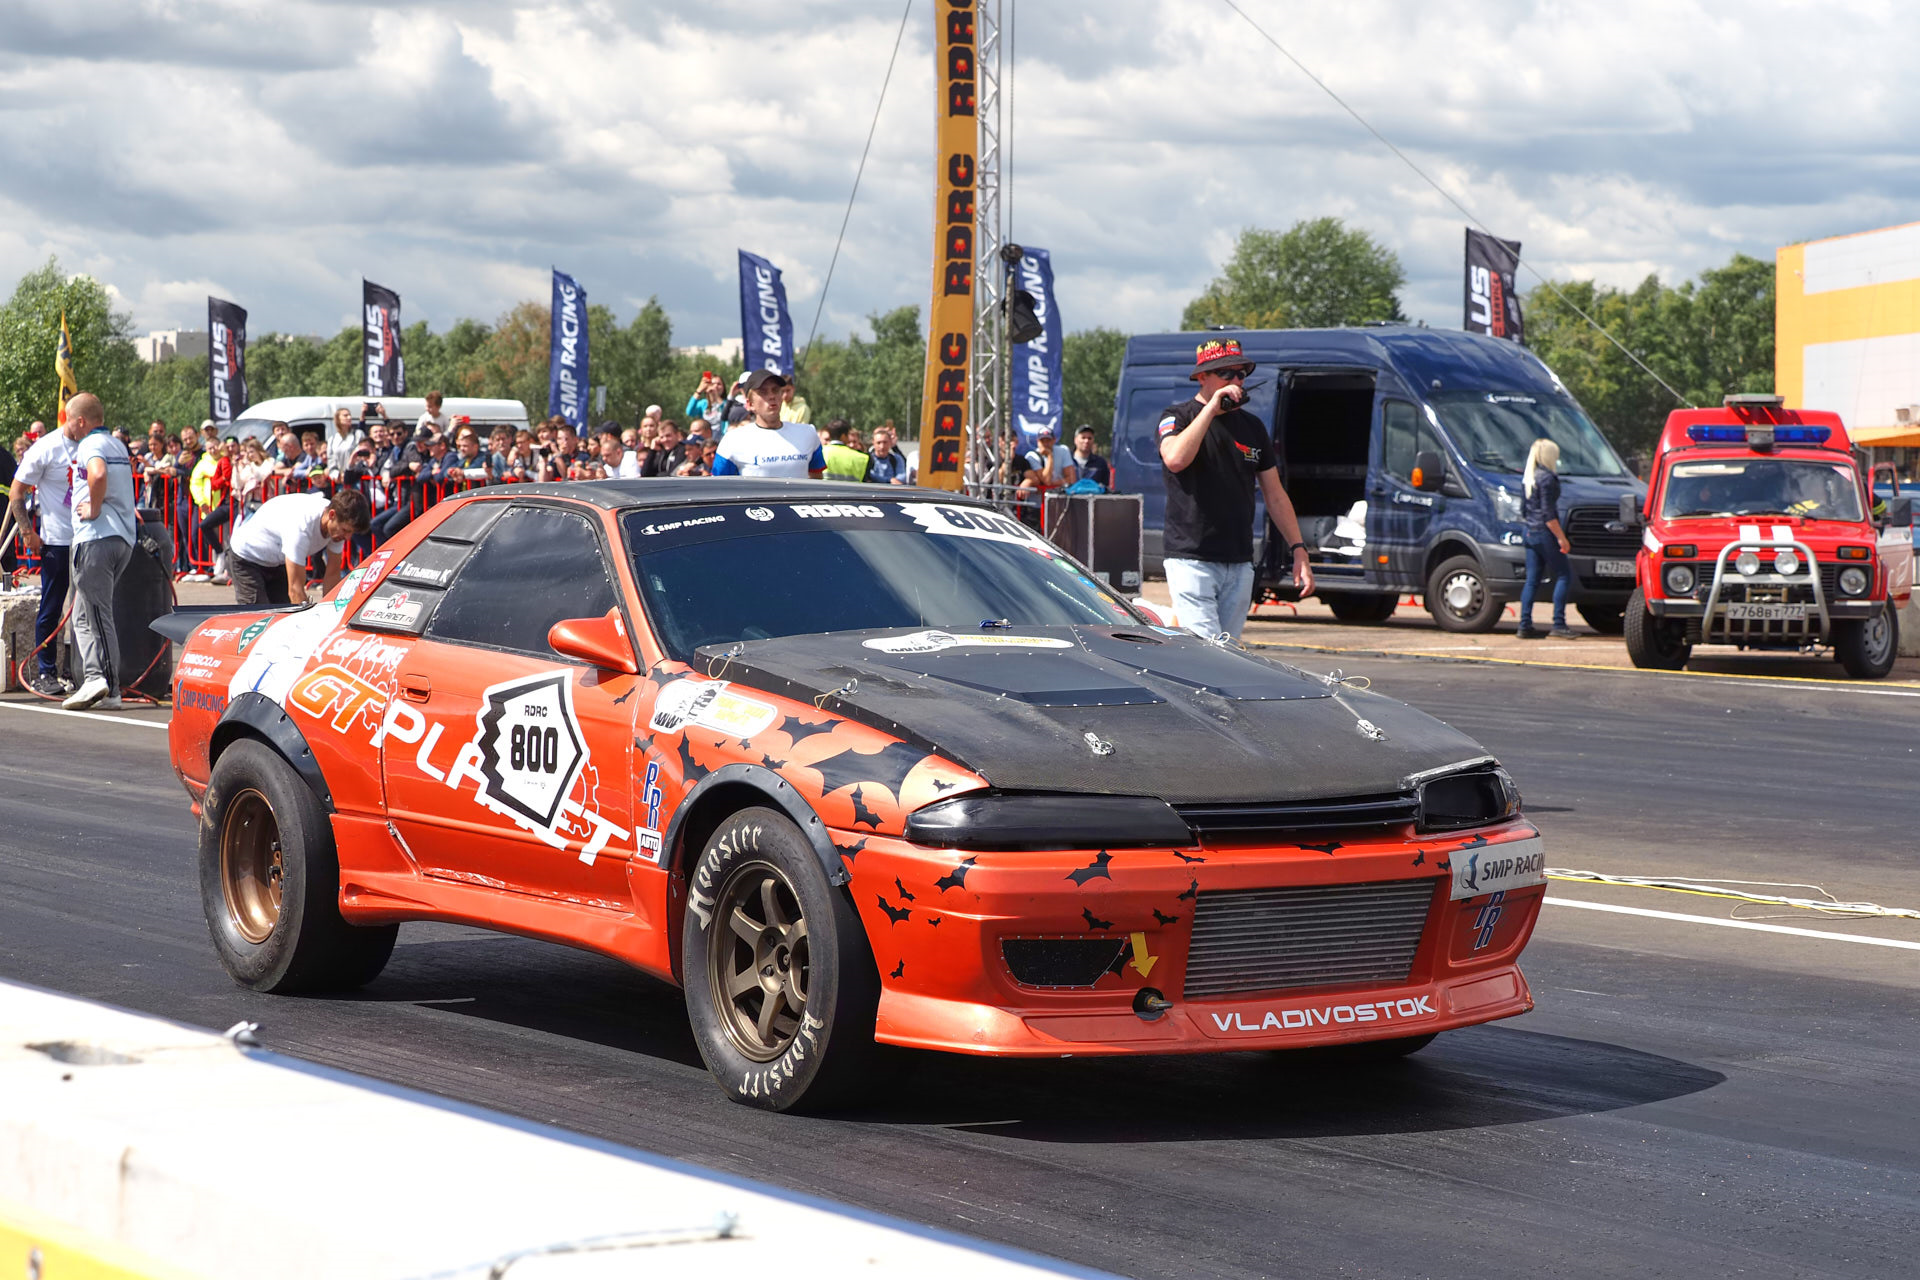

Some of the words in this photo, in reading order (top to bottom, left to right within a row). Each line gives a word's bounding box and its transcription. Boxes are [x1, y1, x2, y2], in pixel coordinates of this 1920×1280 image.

[944, 153, 974, 297] RDRC
[559, 283, 580, 368] RACING
[755, 266, 782, 357] RACING
[1471, 265, 1491, 337] US
[212, 321, 231, 426] GPLUS
[560, 369, 578, 420] SMP
[1028, 355, 1049, 415] SMP
[930, 332, 967, 475] RDRC
[781, 453, 808, 462] RACING
[657, 521, 681, 532] SMP
[683, 515, 726, 529] RACING
[789, 504, 885, 519] RDRC
[934, 506, 1032, 541] 800
[182, 689, 197, 708] SMP
[197, 694, 226, 714] RACING
[289, 663, 388, 735] GT
[524, 704, 548, 717] RDRC
[510, 724, 559, 775] 800
[689, 824, 763, 931] Hoosier
[1482, 857, 1514, 881] SMP
[1211, 995, 1436, 1032] VLADIVOSTOK
